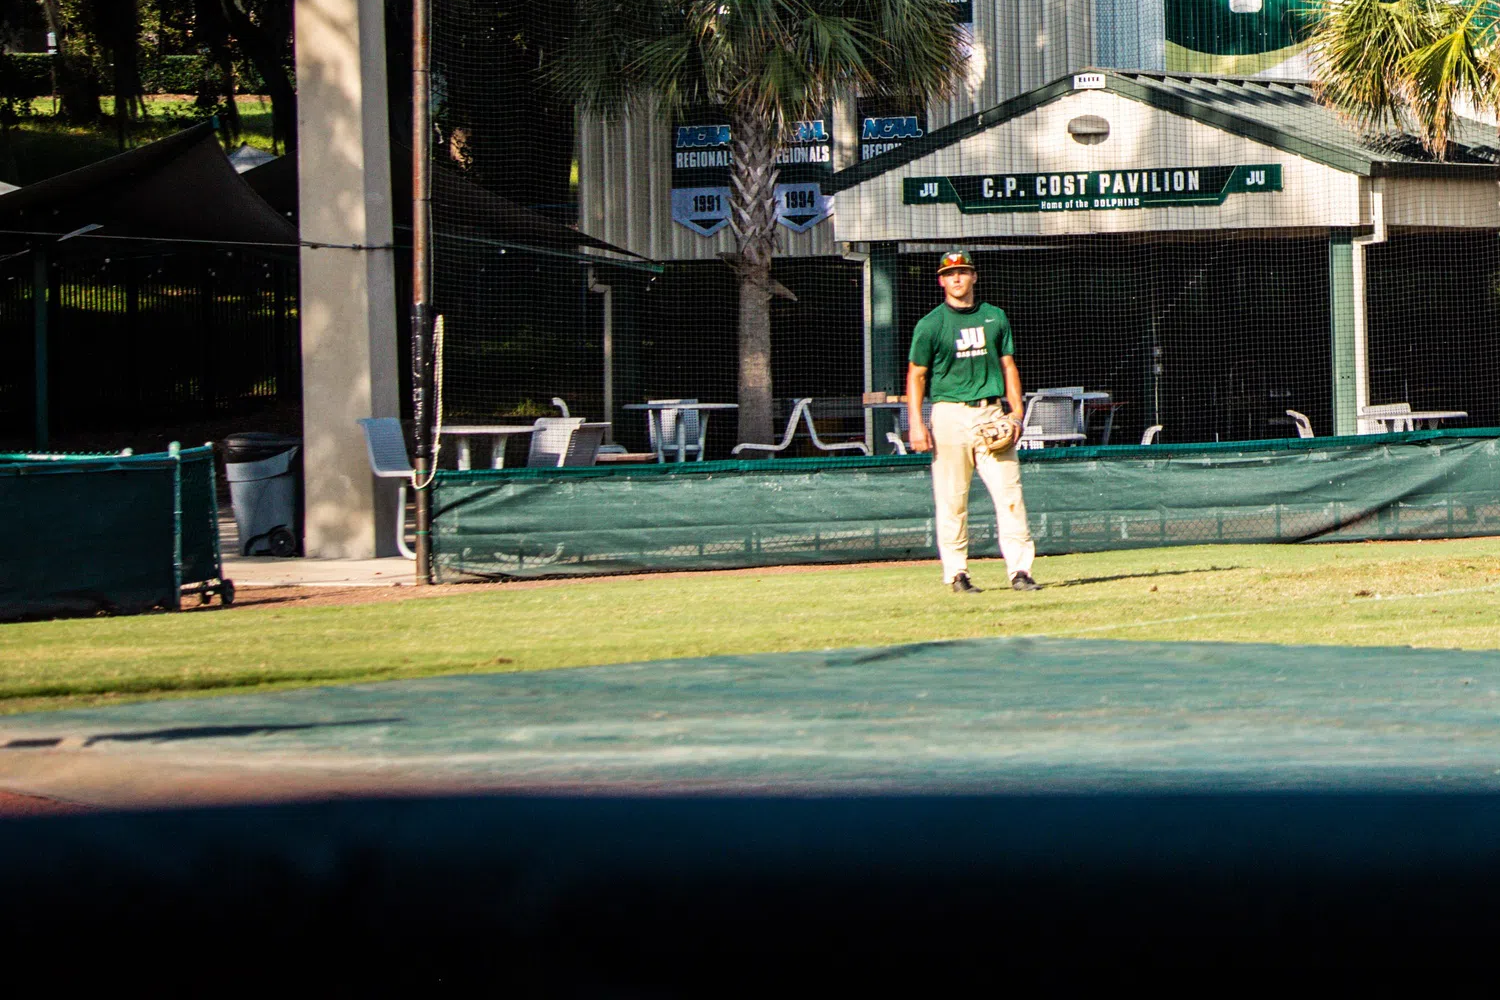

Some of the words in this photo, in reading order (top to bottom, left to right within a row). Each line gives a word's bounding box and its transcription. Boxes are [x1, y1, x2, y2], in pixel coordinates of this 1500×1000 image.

[777, 145, 829, 163] EGIONALS
[983, 177, 1025, 198] C.P.
[1036, 174, 1088, 196] COST
[1098, 170, 1200, 194] PAVILION
[1246, 170, 1265, 186] JU
[920, 183, 938, 197] JU
[693, 195, 721, 212] 1991
[784, 190, 815, 209] 1994
[1041, 201, 1062, 210] Home
[1065, 200, 1073, 208] of
[1075, 199, 1089, 208] the
[1094, 197, 1140, 208] DOLPHINS
[956, 326, 986, 351] JU
